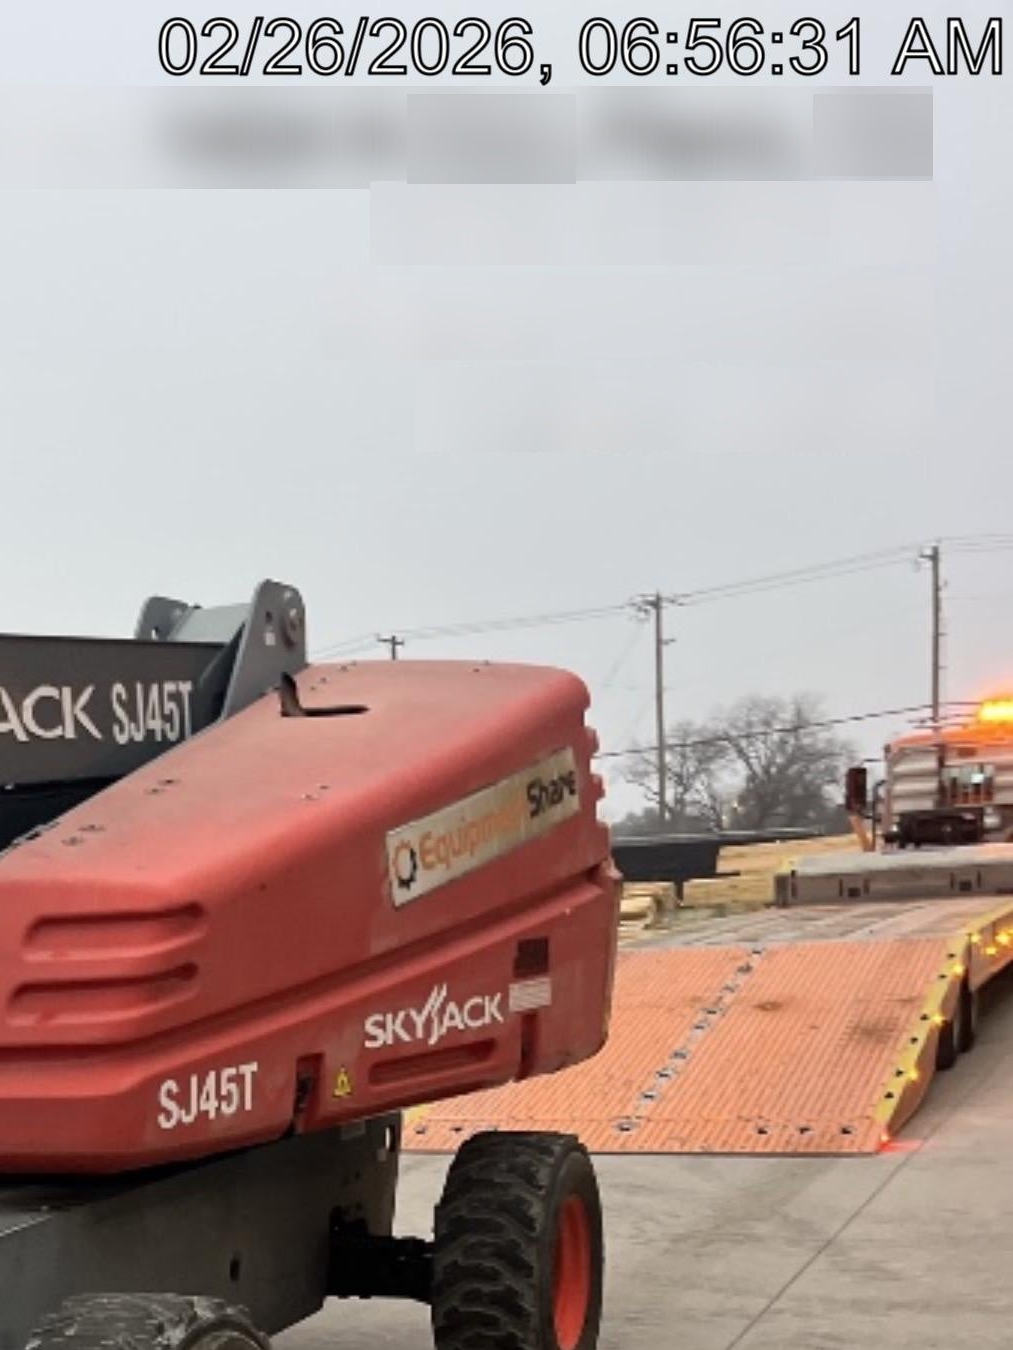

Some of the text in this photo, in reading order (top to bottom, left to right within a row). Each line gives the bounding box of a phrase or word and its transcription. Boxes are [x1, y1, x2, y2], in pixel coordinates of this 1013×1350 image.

[111, 680, 192, 745] SJ45T
[364, 983, 504, 1049] SKYJACK
[157, 1062, 258, 1129] SJ45T
